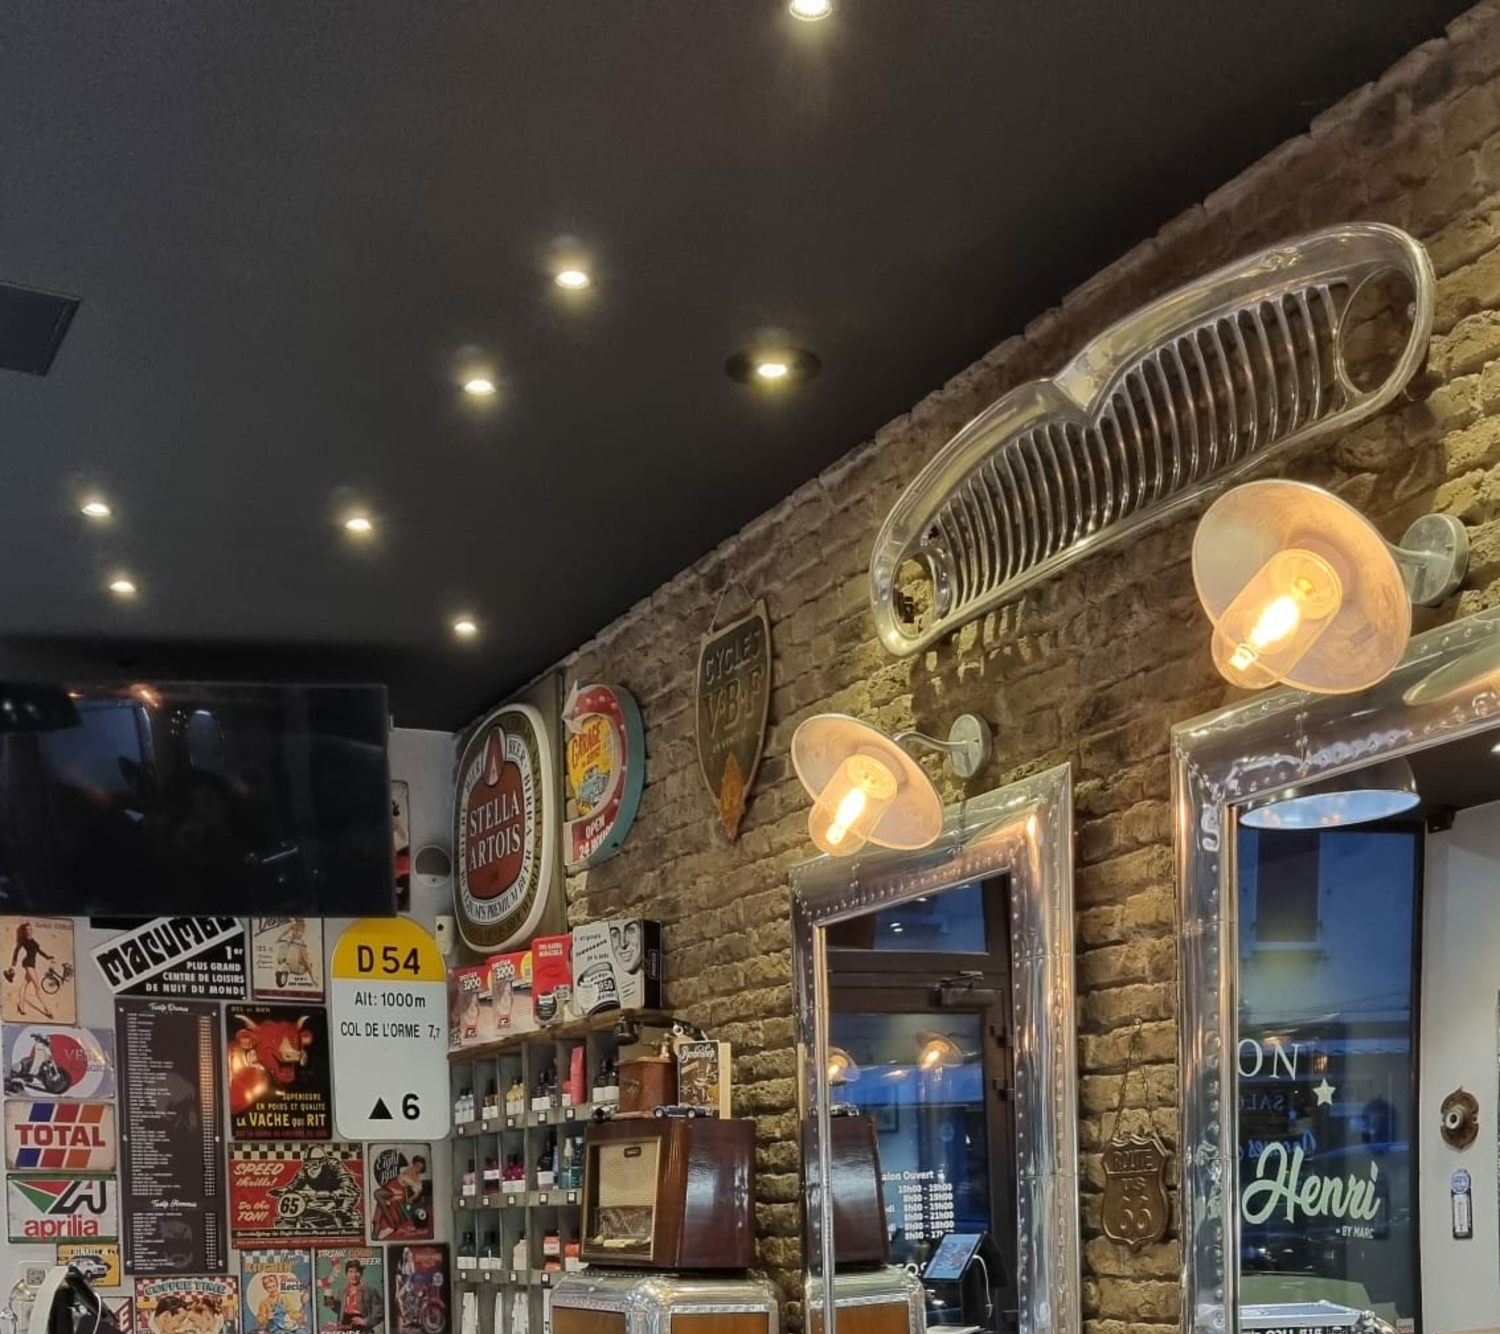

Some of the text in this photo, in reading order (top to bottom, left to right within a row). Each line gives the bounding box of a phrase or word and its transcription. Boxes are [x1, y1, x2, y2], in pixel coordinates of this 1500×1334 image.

[469, 788, 521, 838] STELLA
[585, 814, 605, 839] OPEN
[469, 823, 522, 874] ARTOIS
[186, 961, 242, 972] PLUS GRAND
[162, 972, 245, 983] CENTRE DE LOISIRS
[145, 983, 245, 996] DE NUIT DU MONDE
[354, 991, 426, 1008] Alt: 1000m
[340, 1021, 362, 1038] COL
[365, 1022, 379, 1038] DE
[382, 1022, 420, 1038] L'ORME
[402, 1093, 421, 1121] 6
[236, 1116, 247, 1127] LA
[249, 1112, 289, 1128] VACHE
[306, 1113, 327, 1127] RIT
[15, 1124, 106, 1147] TOTAL
[1113, 1149, 1154, 1169] ROUTE
[233, 1162, 285, 1176] SPEED
[1242, 1142, 1381, 1225] Henri
[280, 1196, 300, 1214] 65
[24, 1215, 99, 1239] aprilia
[1342, 1226, 1353, 1237] BY
